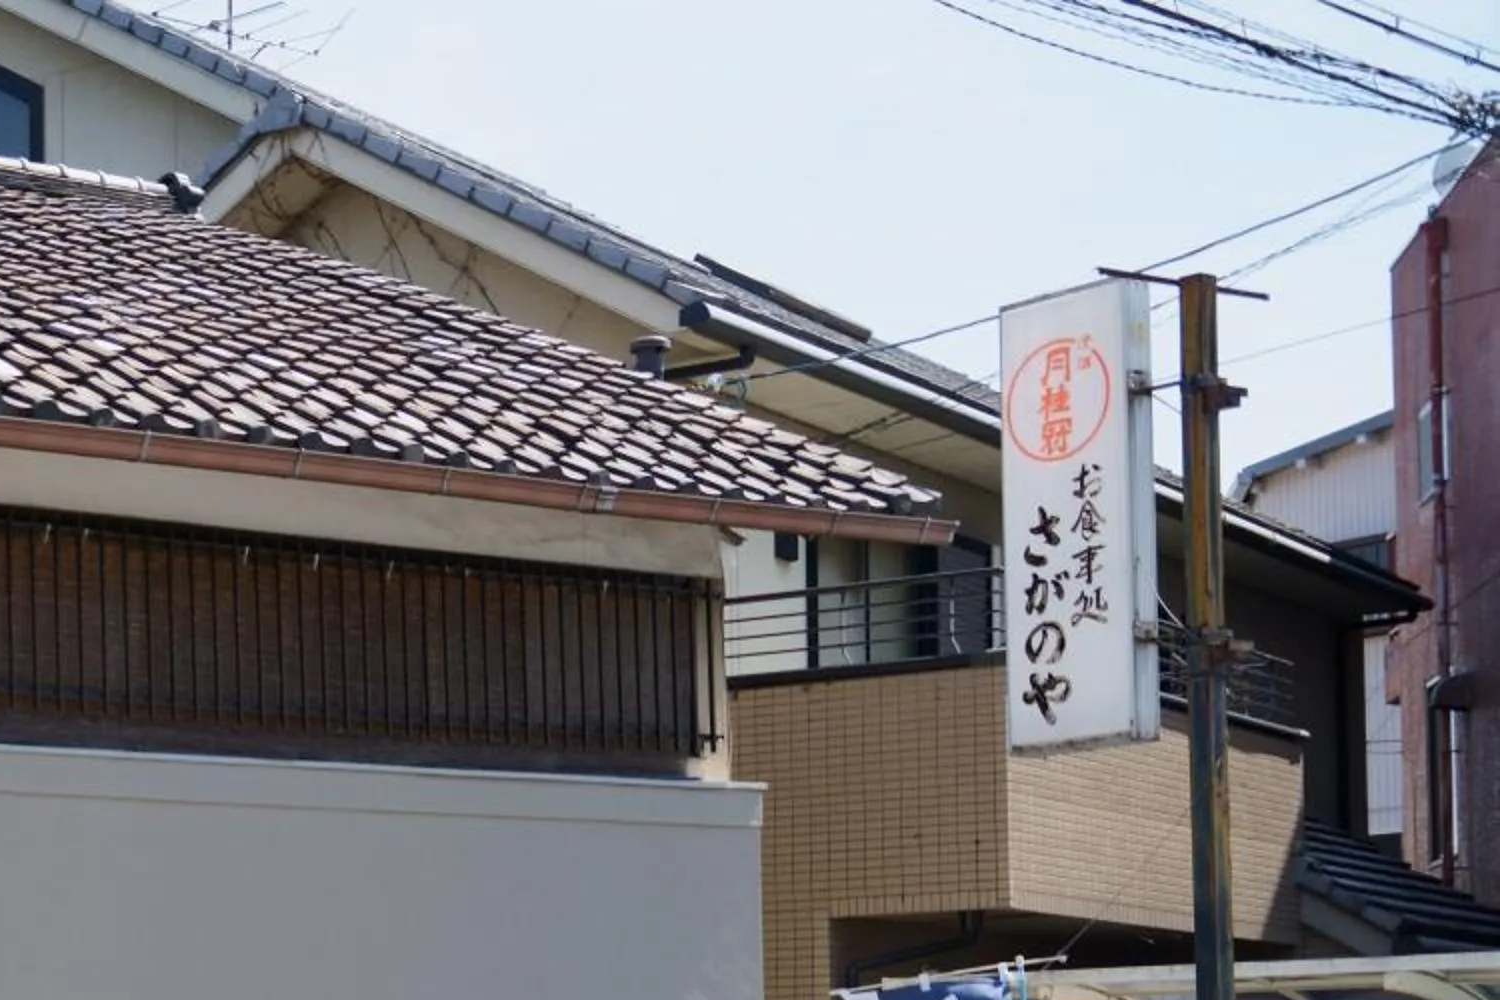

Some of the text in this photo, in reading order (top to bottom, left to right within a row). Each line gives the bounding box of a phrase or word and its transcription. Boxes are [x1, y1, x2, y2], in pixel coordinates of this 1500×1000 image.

[1022, 506, 1071, 726] さがのや
[1071, 463, 1108, 626] お食事処
